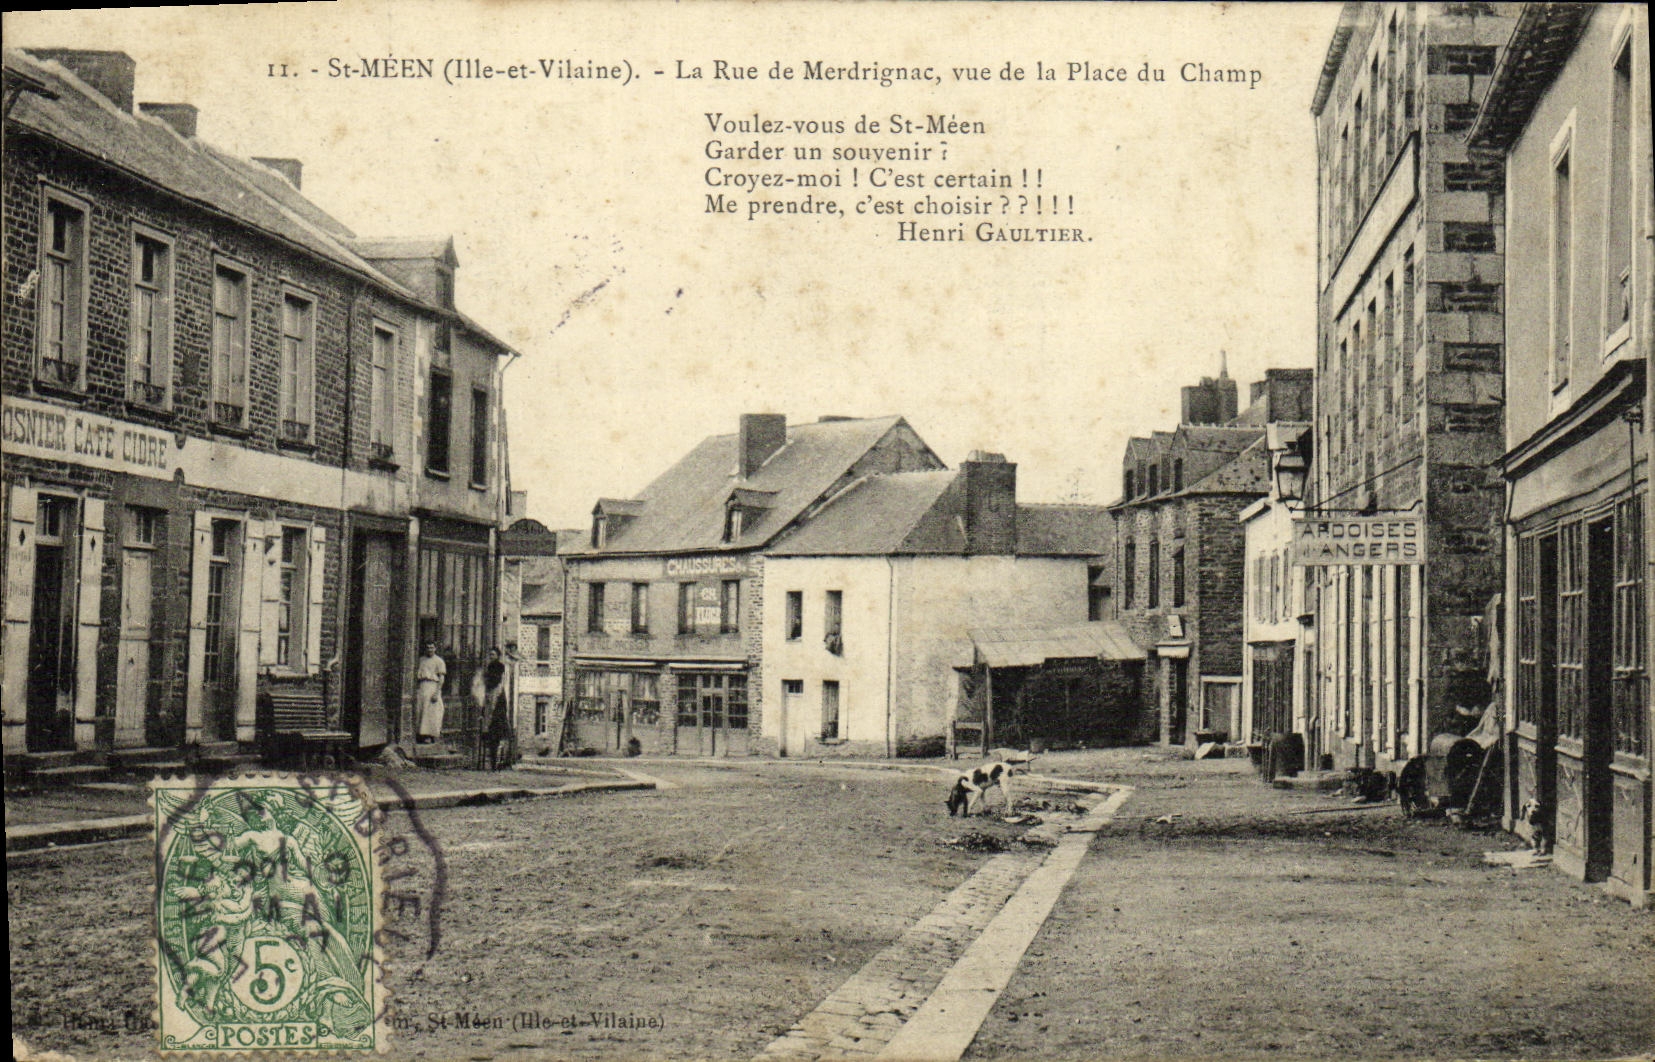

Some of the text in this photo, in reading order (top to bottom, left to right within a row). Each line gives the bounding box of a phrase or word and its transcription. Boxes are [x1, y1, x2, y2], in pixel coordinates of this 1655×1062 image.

[122, 429, 167, 470] CIDRE
[1301, 522, 1417, 538] ARDOISES
[221, 1025, 314, 1047] POSTES
